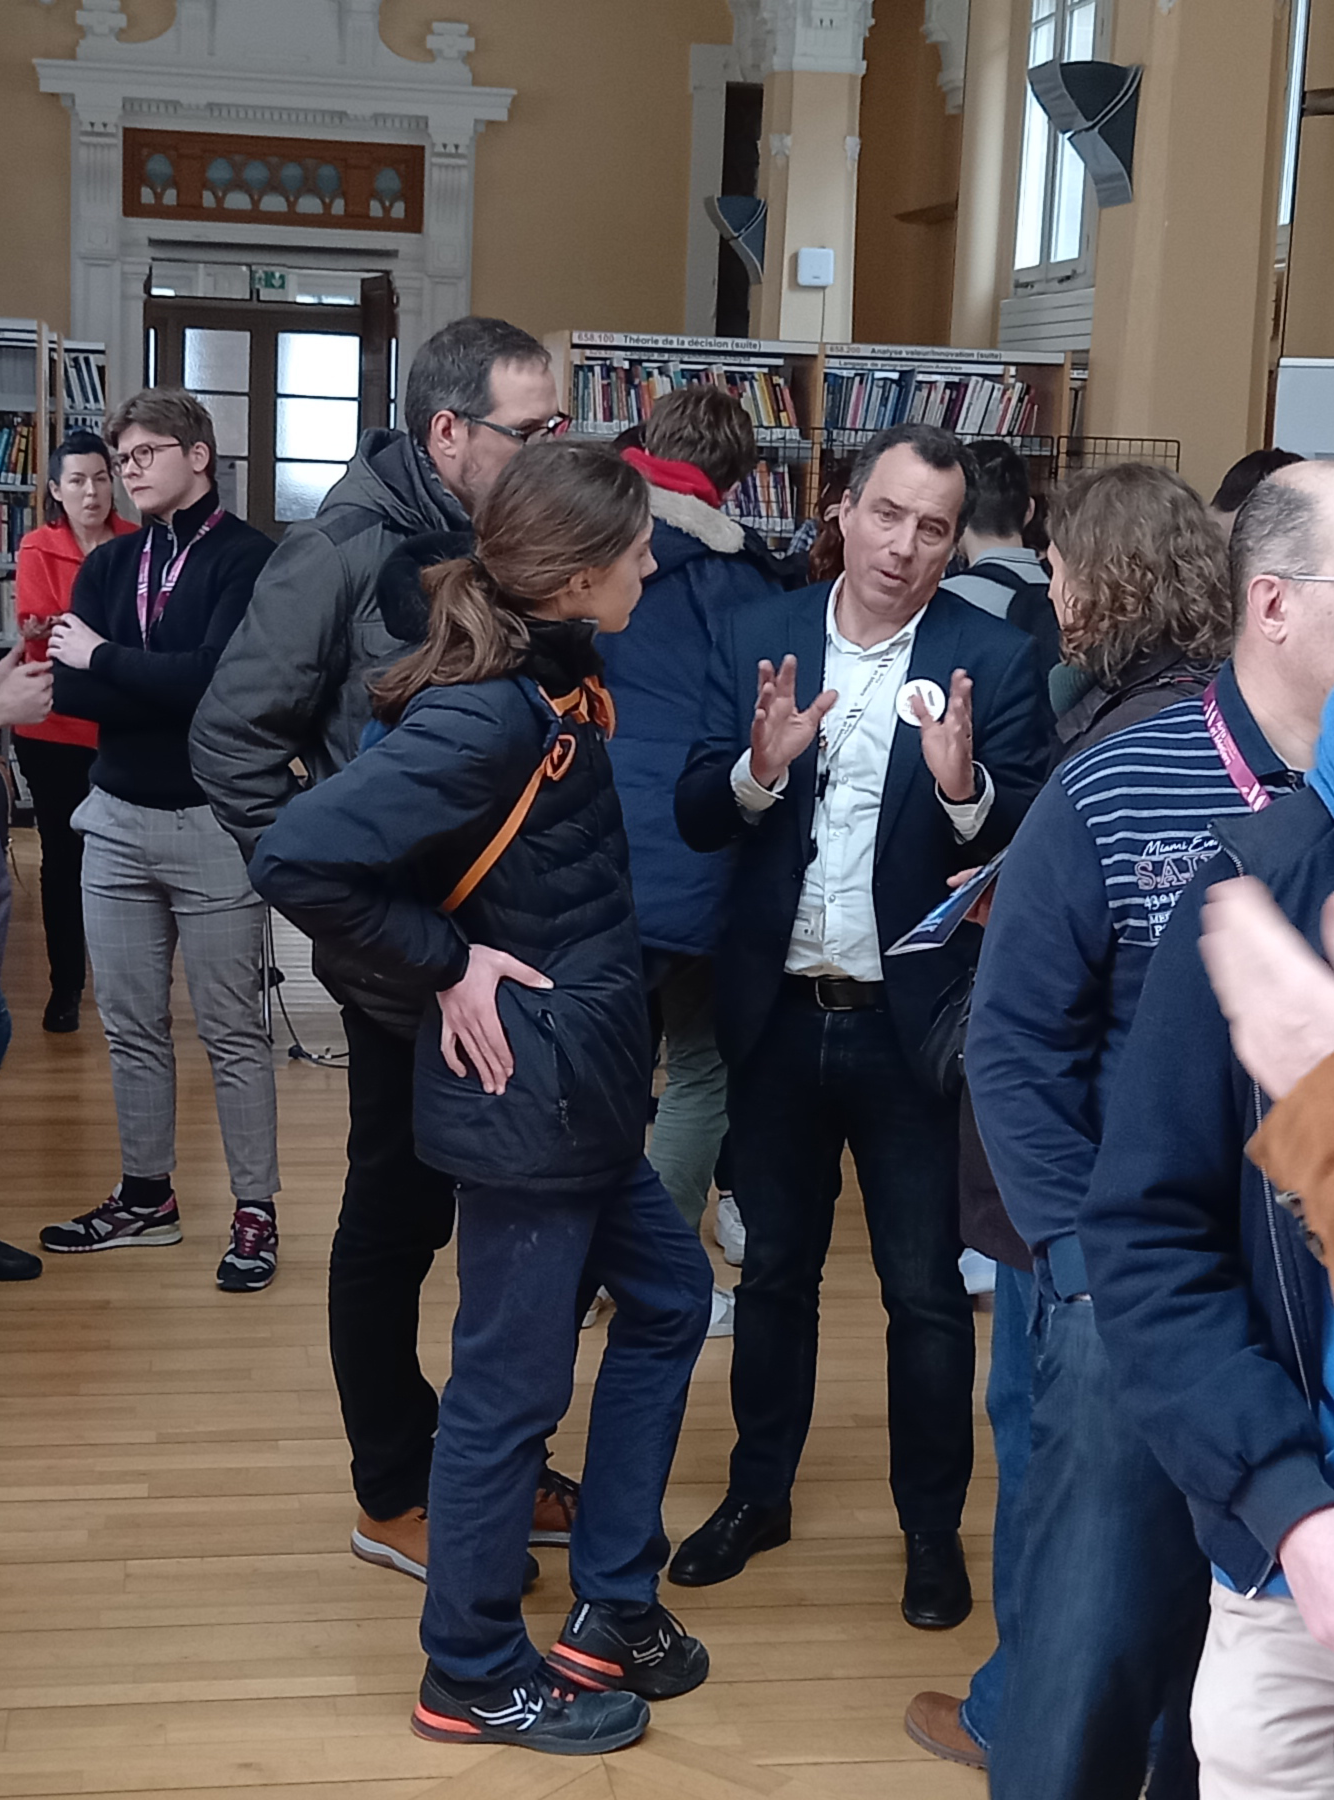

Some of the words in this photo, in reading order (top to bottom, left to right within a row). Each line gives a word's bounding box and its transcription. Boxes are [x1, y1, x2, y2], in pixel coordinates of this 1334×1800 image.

[577, 333, 615, 344] 658.100
[623, 335, 659, 346] Théorie
[662, 337, 674, 347] de
[677, 337, 685, 347] la
[688, 337, 728, 349] décision
[730, 339, 762, 351] (suite)
[870, 348, 903, 359] Analyse
[976, 351, 1002, 361] (suite)
[1142, 840, 1187, 859] Miami
